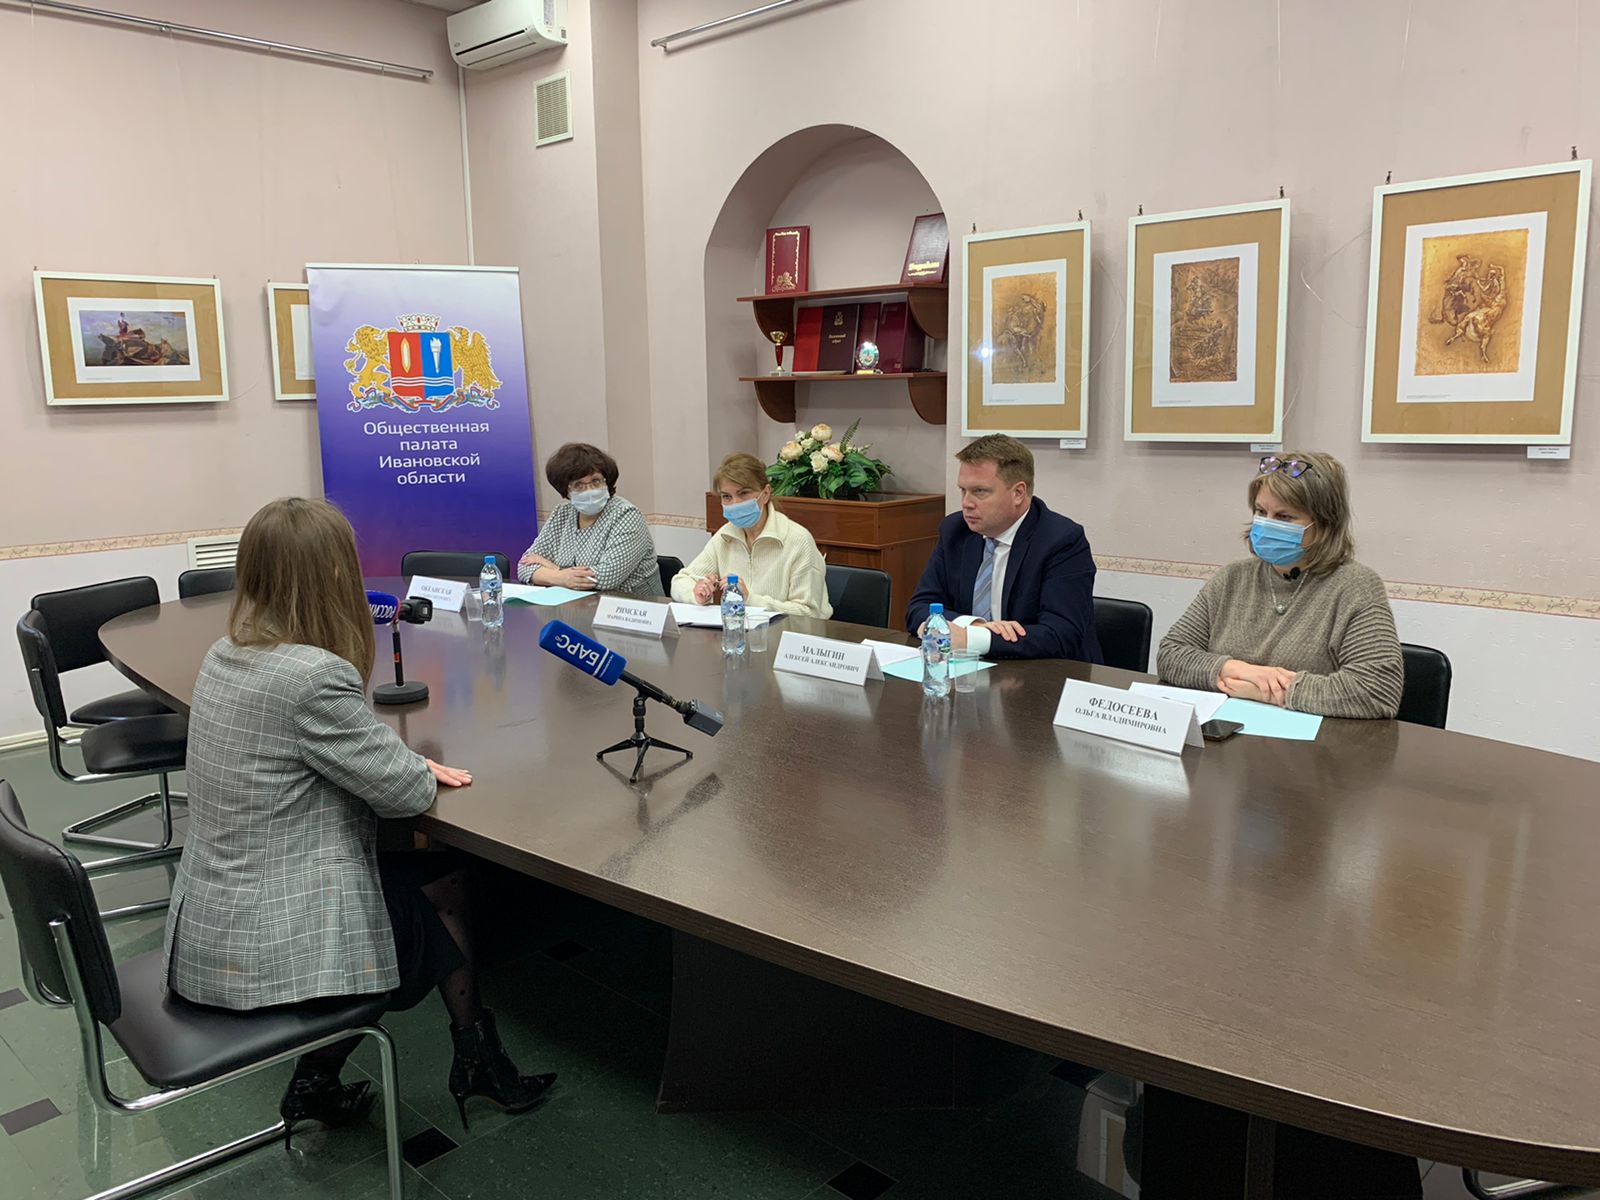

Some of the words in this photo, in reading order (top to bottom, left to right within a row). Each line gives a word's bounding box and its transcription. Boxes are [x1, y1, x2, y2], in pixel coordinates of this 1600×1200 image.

[363, 421, 490, 437] Общественная
[400, 439, 458, 451] палата
[379, 453, 481, 469] Ивановской
[397, 472, 466, 485] области
[615, 606, 648, 617] РИМСКАЯ
[556, 634, 600, 667] БАРС
[801, 645, 845, 660] МАЛЫГИН
[784, 653, 810, 663] АЛЕКСЕЙ
[810, 659, 860, 672] АЛЕКСАНДРОВИЧ
[1088, 697, 1158, 721] ФЕДОСЕЕВА
[1075, 707, 1100, 719] ОЛЬГА
[1101, 713, 1167, 734] ВЛАДИМИРОВНА
